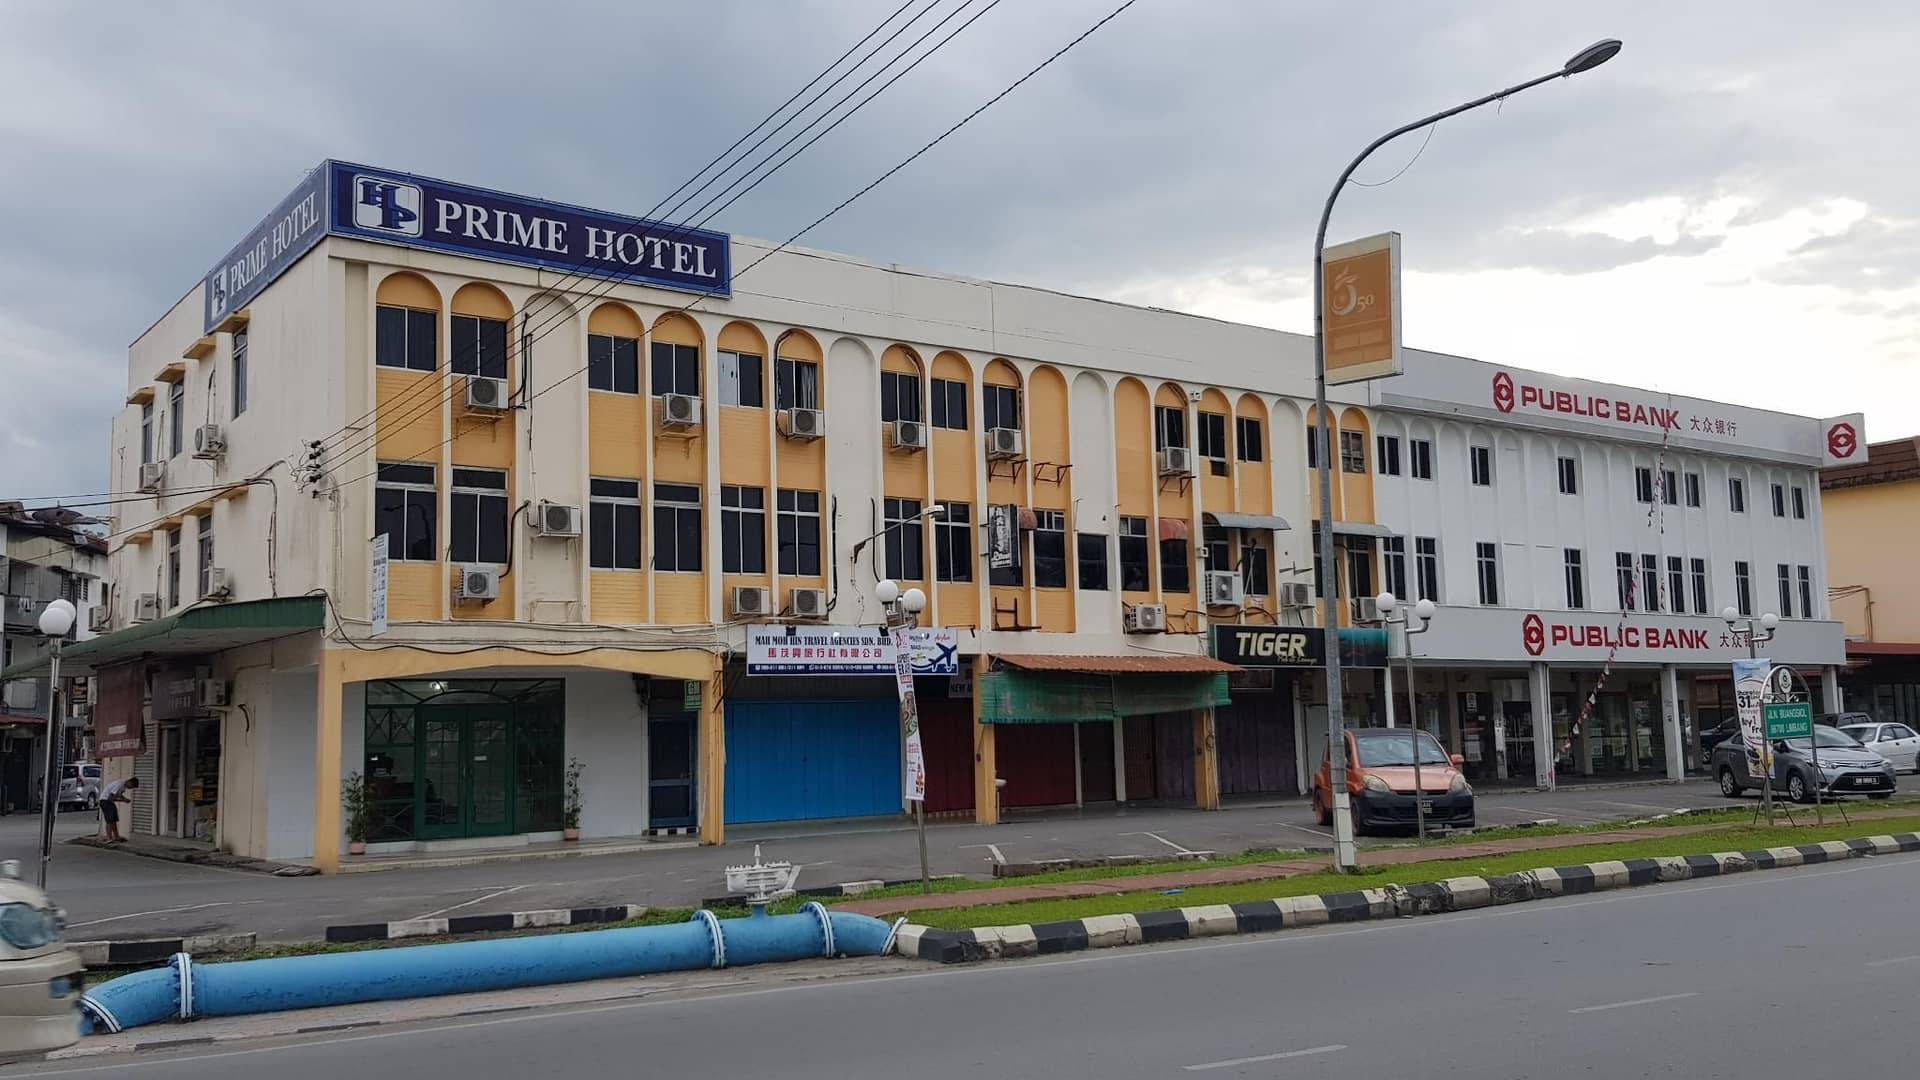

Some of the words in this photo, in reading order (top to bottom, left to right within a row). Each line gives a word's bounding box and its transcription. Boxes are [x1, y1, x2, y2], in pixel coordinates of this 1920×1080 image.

[230, 237, 268, 297] PRIME
[271, 192, 319, 260] HOTEL
[435, 198, 569, 254] PRIME
[585, 226, 717, 278] HOTEL
[1521, 385, 1611, 418] PUBLIC
[1615, 401, 1682, 431] BANK
[1690, 415, 1737, 437] 大众银行
[755, 635, 771, 645] MAH
[772, 635, 788, 645] MOH
[804, 636, 828, 645] TRAVEL
[829, 636, 860, 646] AGENCIES
[861, 637, 876, 646] SDN.
[877, 637, 893, 646] BHD.
[1235, 632, 1307, 657] TIGER
[1551, 625, 1640, 648] PUBLIC
[1645, 628, 1710, 649] BANK
[1738, 695, 1751, 708] 31
